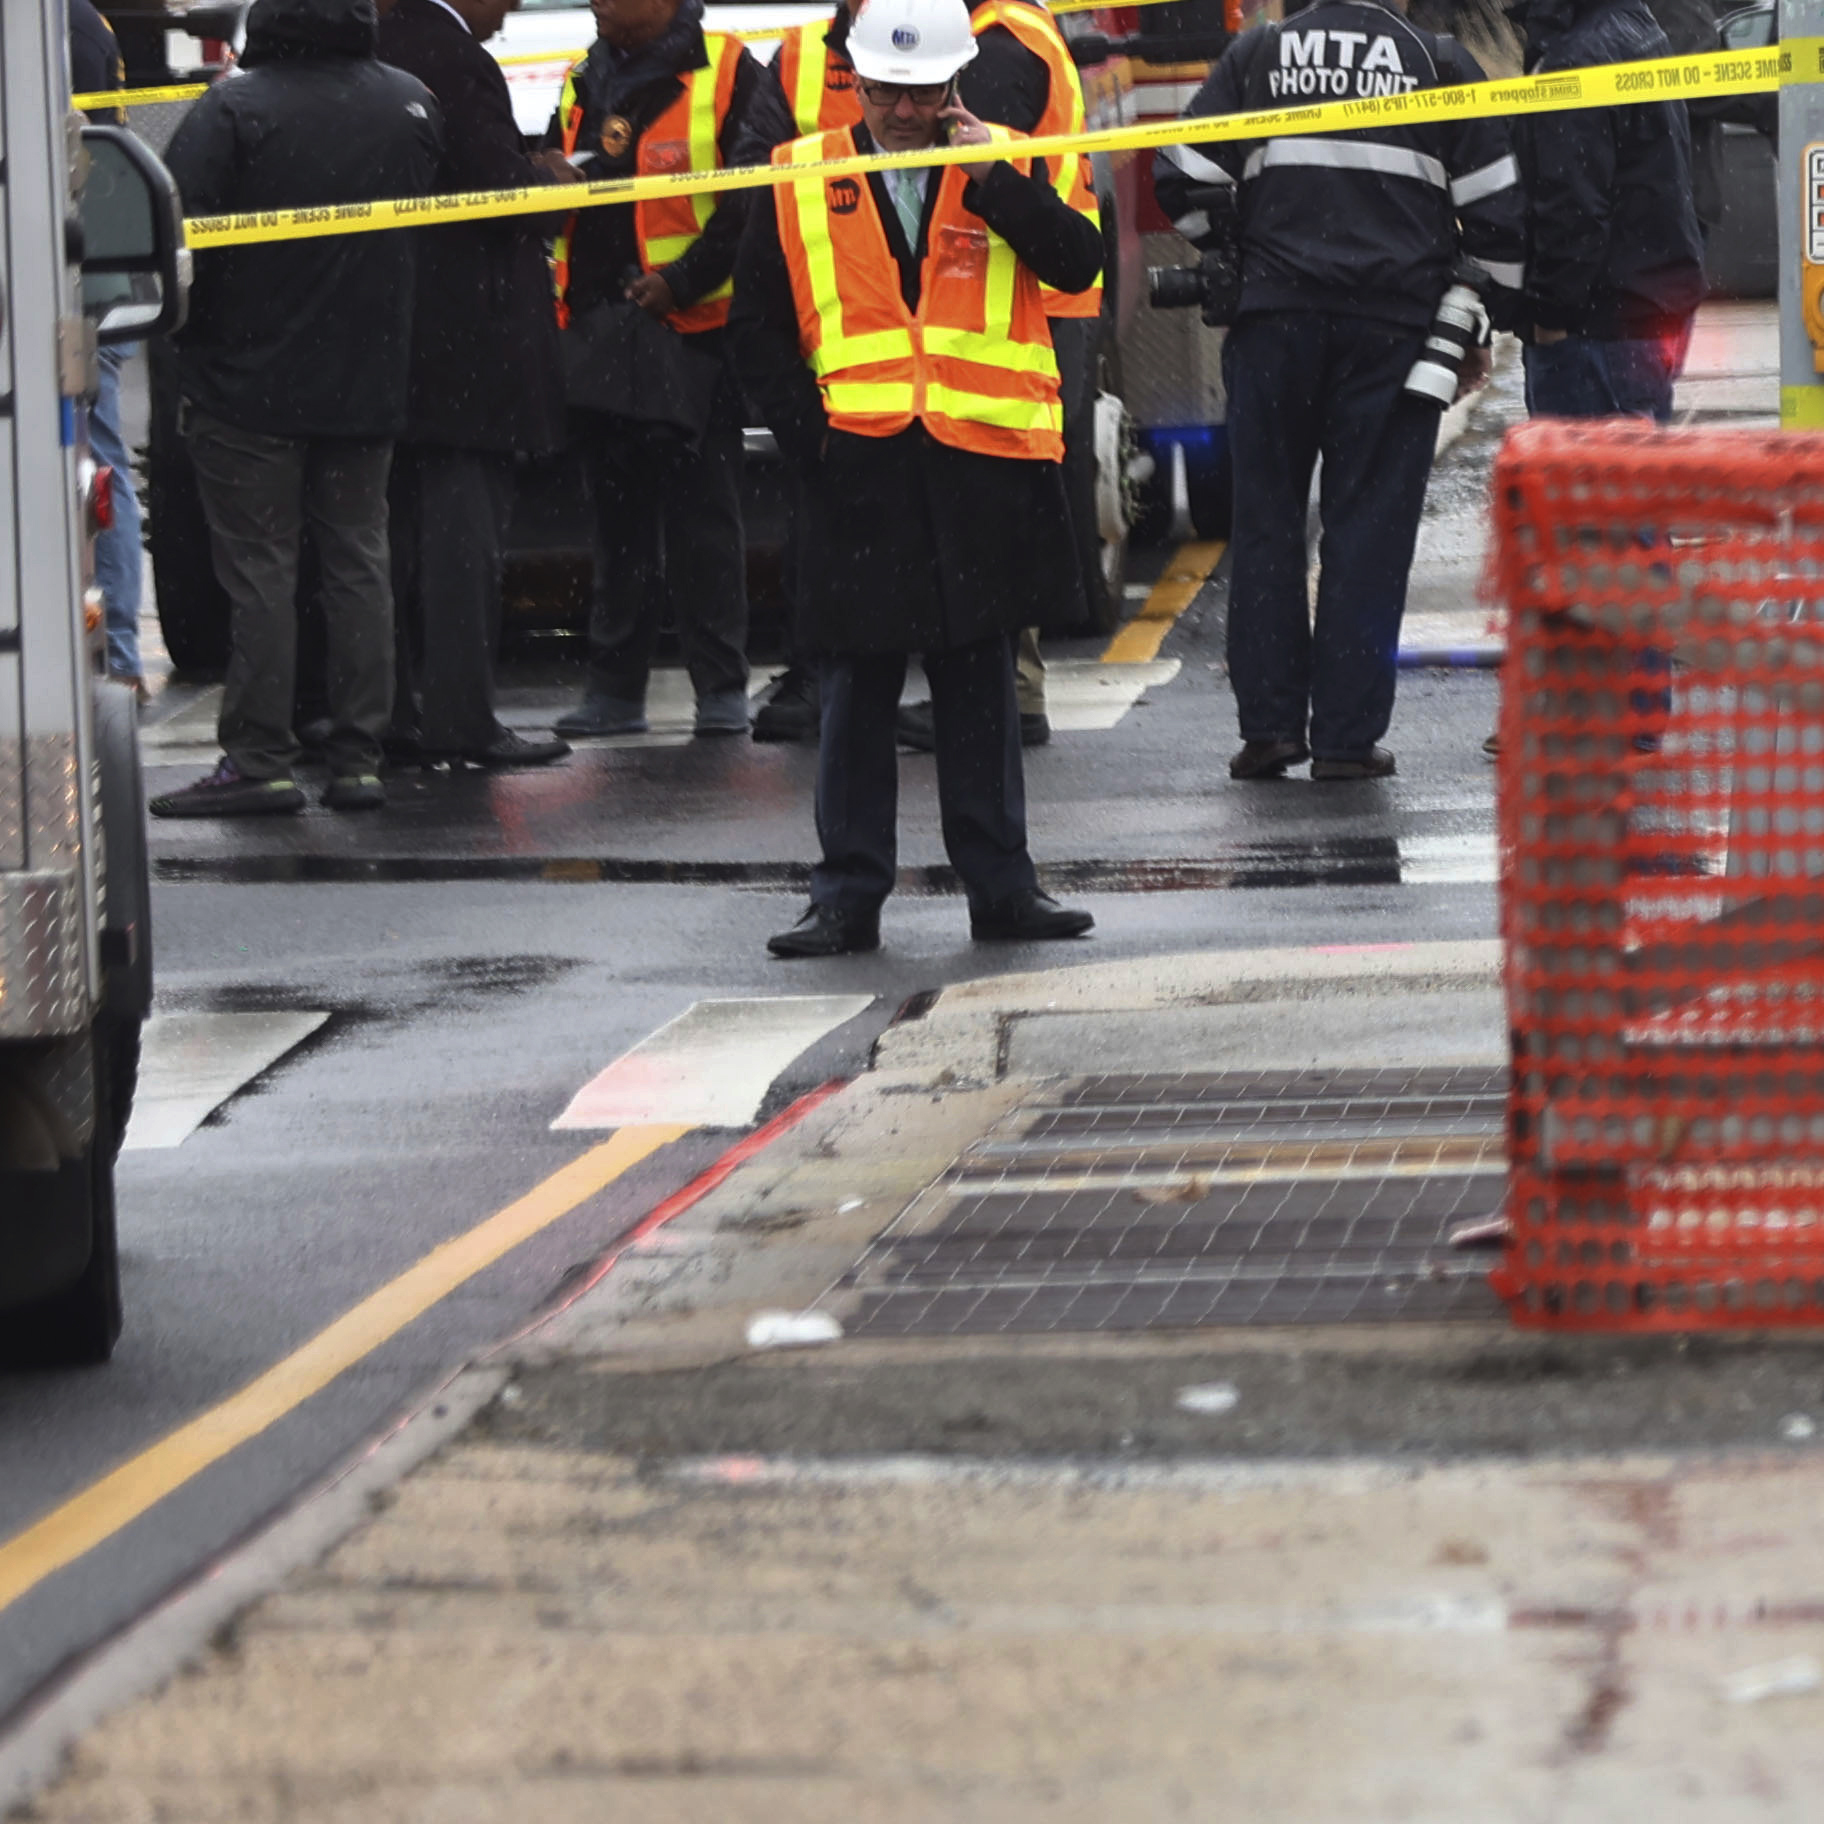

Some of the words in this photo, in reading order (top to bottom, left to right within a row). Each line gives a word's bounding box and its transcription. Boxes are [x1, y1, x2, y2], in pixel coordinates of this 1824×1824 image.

[1280, 29, 1404, 73] MTA
[1269, 67, 1349, 98] PHOTO
[1357, 70, 1418, 98] UNIT
